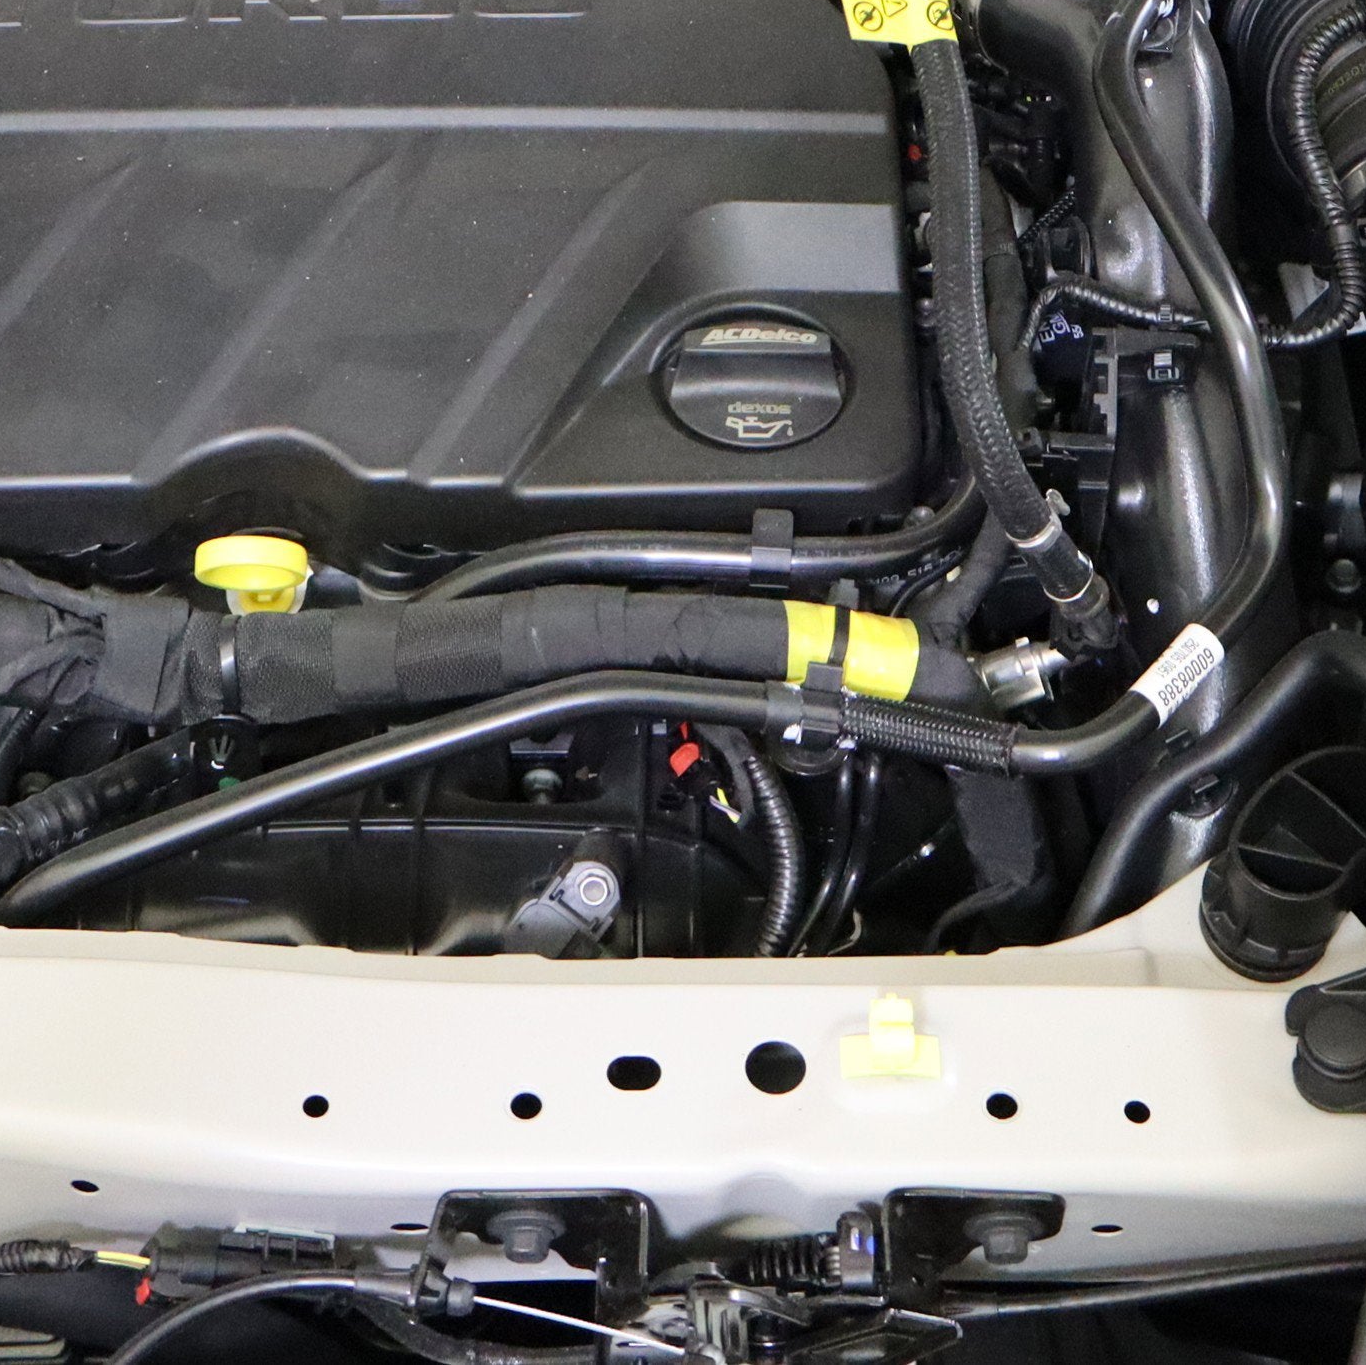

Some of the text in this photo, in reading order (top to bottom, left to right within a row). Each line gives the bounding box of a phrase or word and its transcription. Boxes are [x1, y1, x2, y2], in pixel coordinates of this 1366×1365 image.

[702, 328, 818, 345] ACDelco
[727, 401, 793, 415] dexos
[1158, 647, 1215, 707] 60008388
